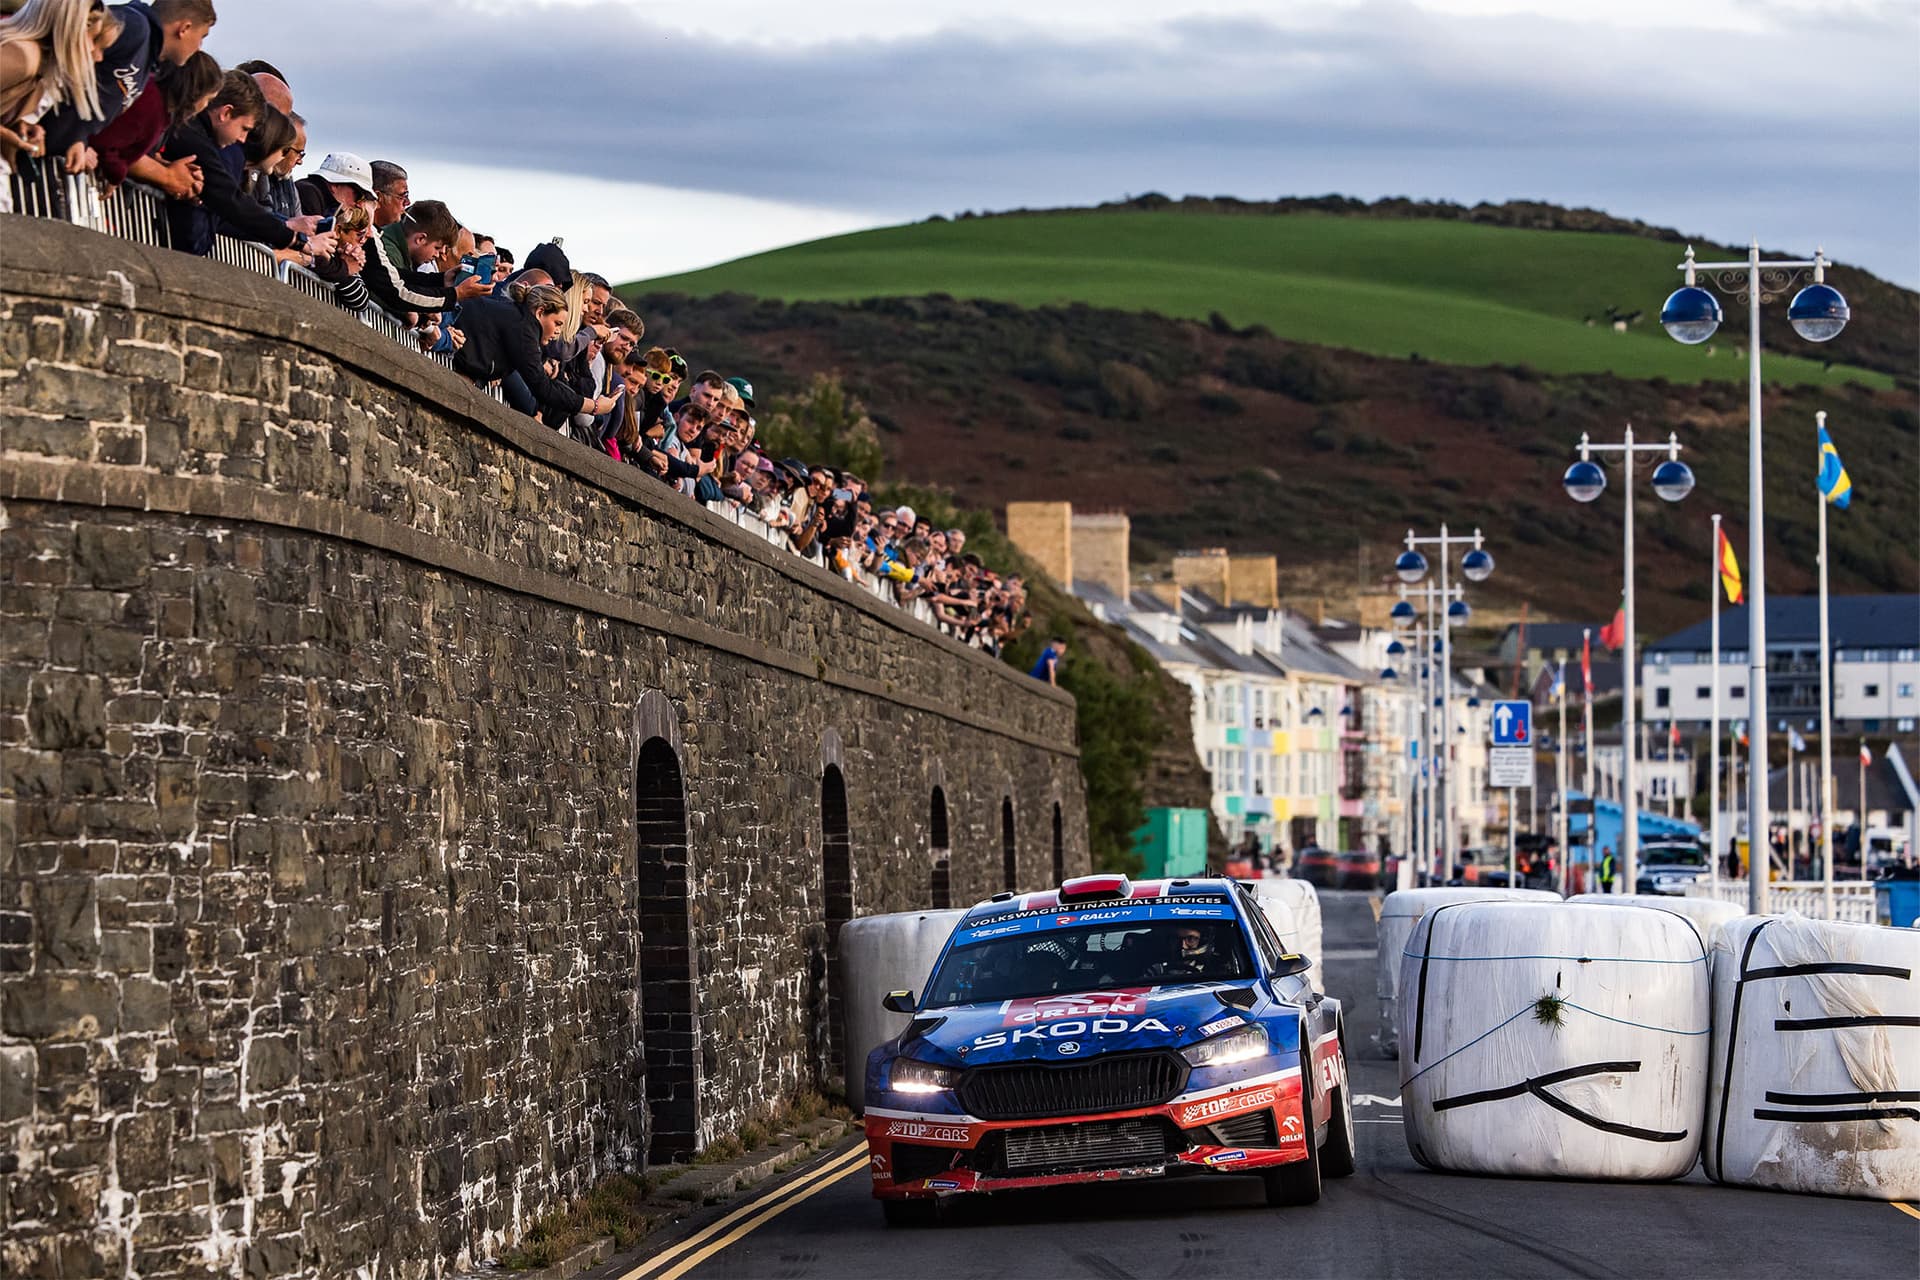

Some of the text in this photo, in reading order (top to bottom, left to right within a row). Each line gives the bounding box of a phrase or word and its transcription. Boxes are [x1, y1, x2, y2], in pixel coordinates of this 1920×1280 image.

[970, 897, 1222, 928] VOLKSWAGEN FINANCIAL SERVICES
[1080, 911, 1120, 921] RALLY
[1014, 1003, 1136, 1022] ORLEN
[1199, 1097, 1230, 1116] TOP
[1239, 1089, 1275, 1109] CARS
[903, 1122, 969, 1142] TOP CARS
[1280, 1132, 1303, 1143] ORLEN
